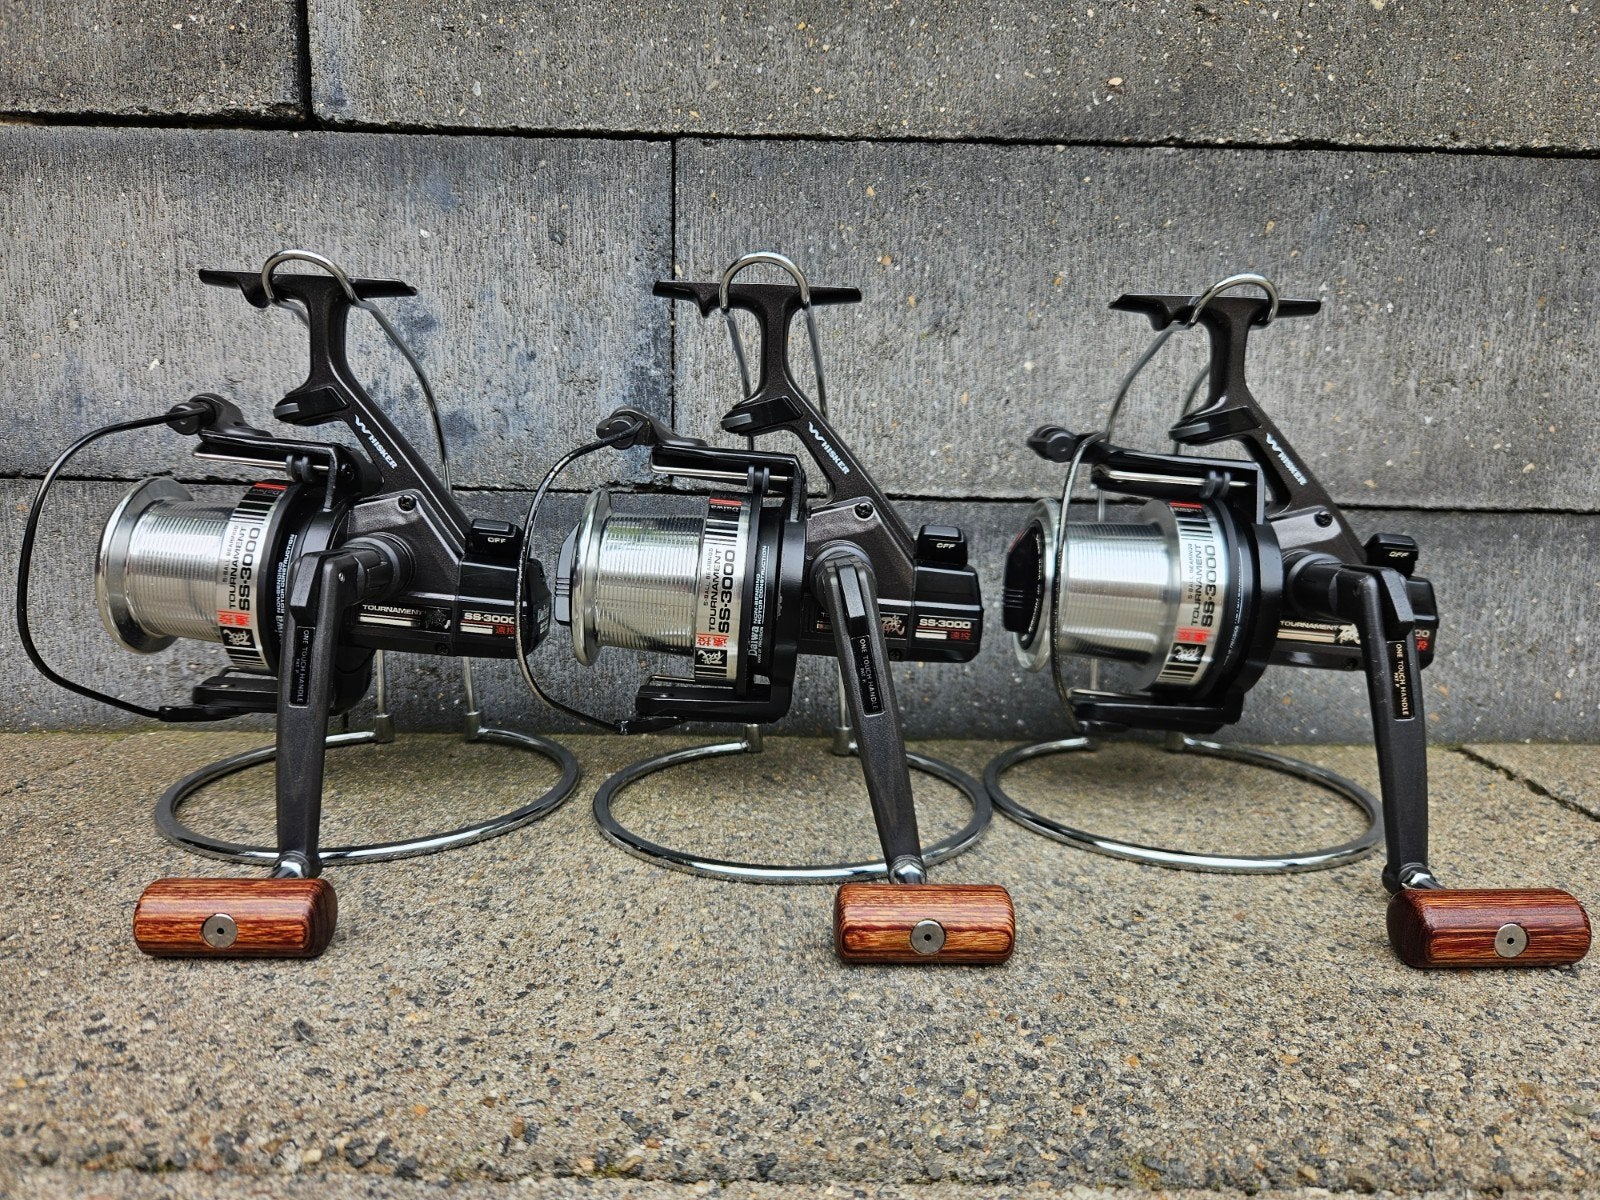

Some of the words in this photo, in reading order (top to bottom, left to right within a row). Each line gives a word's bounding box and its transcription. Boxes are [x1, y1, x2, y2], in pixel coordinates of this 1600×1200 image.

[354, 413, 398, 470] WHISKER
[808, 420, 851, 475] WHISKER
[1265, 432, 1308, 486] WHISKER
[487, 536, 507, 545] OFF
[229, 526, 246, 609] TOURNAMENT
[758, 545, 768, 599] CONSTRUCTION
[708, 549, 722, 632] TOURNAMENT
[752, 573, 761, 624] NON-BENDING
[1190, 544, 1203, 626] TOURNAMENT
[302, 629, 310, 644] ONE
[1280, 620, 1340, 631] TOURNAMENT
[696, 635, 728, 648] 遠投
[748, 625, 760, 656] Daiwa
[859, 638, 868, 653] ONE
[1395, 643, 1404, 658] ONE
[300, 647, 309, 672] TOUCH
[862, 655, 872, 680] TOUCH
[1397, 660, 1406, 685] TOUCH
[296, 673, 306, 702] HANDLE
[867, 681, 879, 710] HANDLE
[1400, 686, 1410, 716] HANDLE
